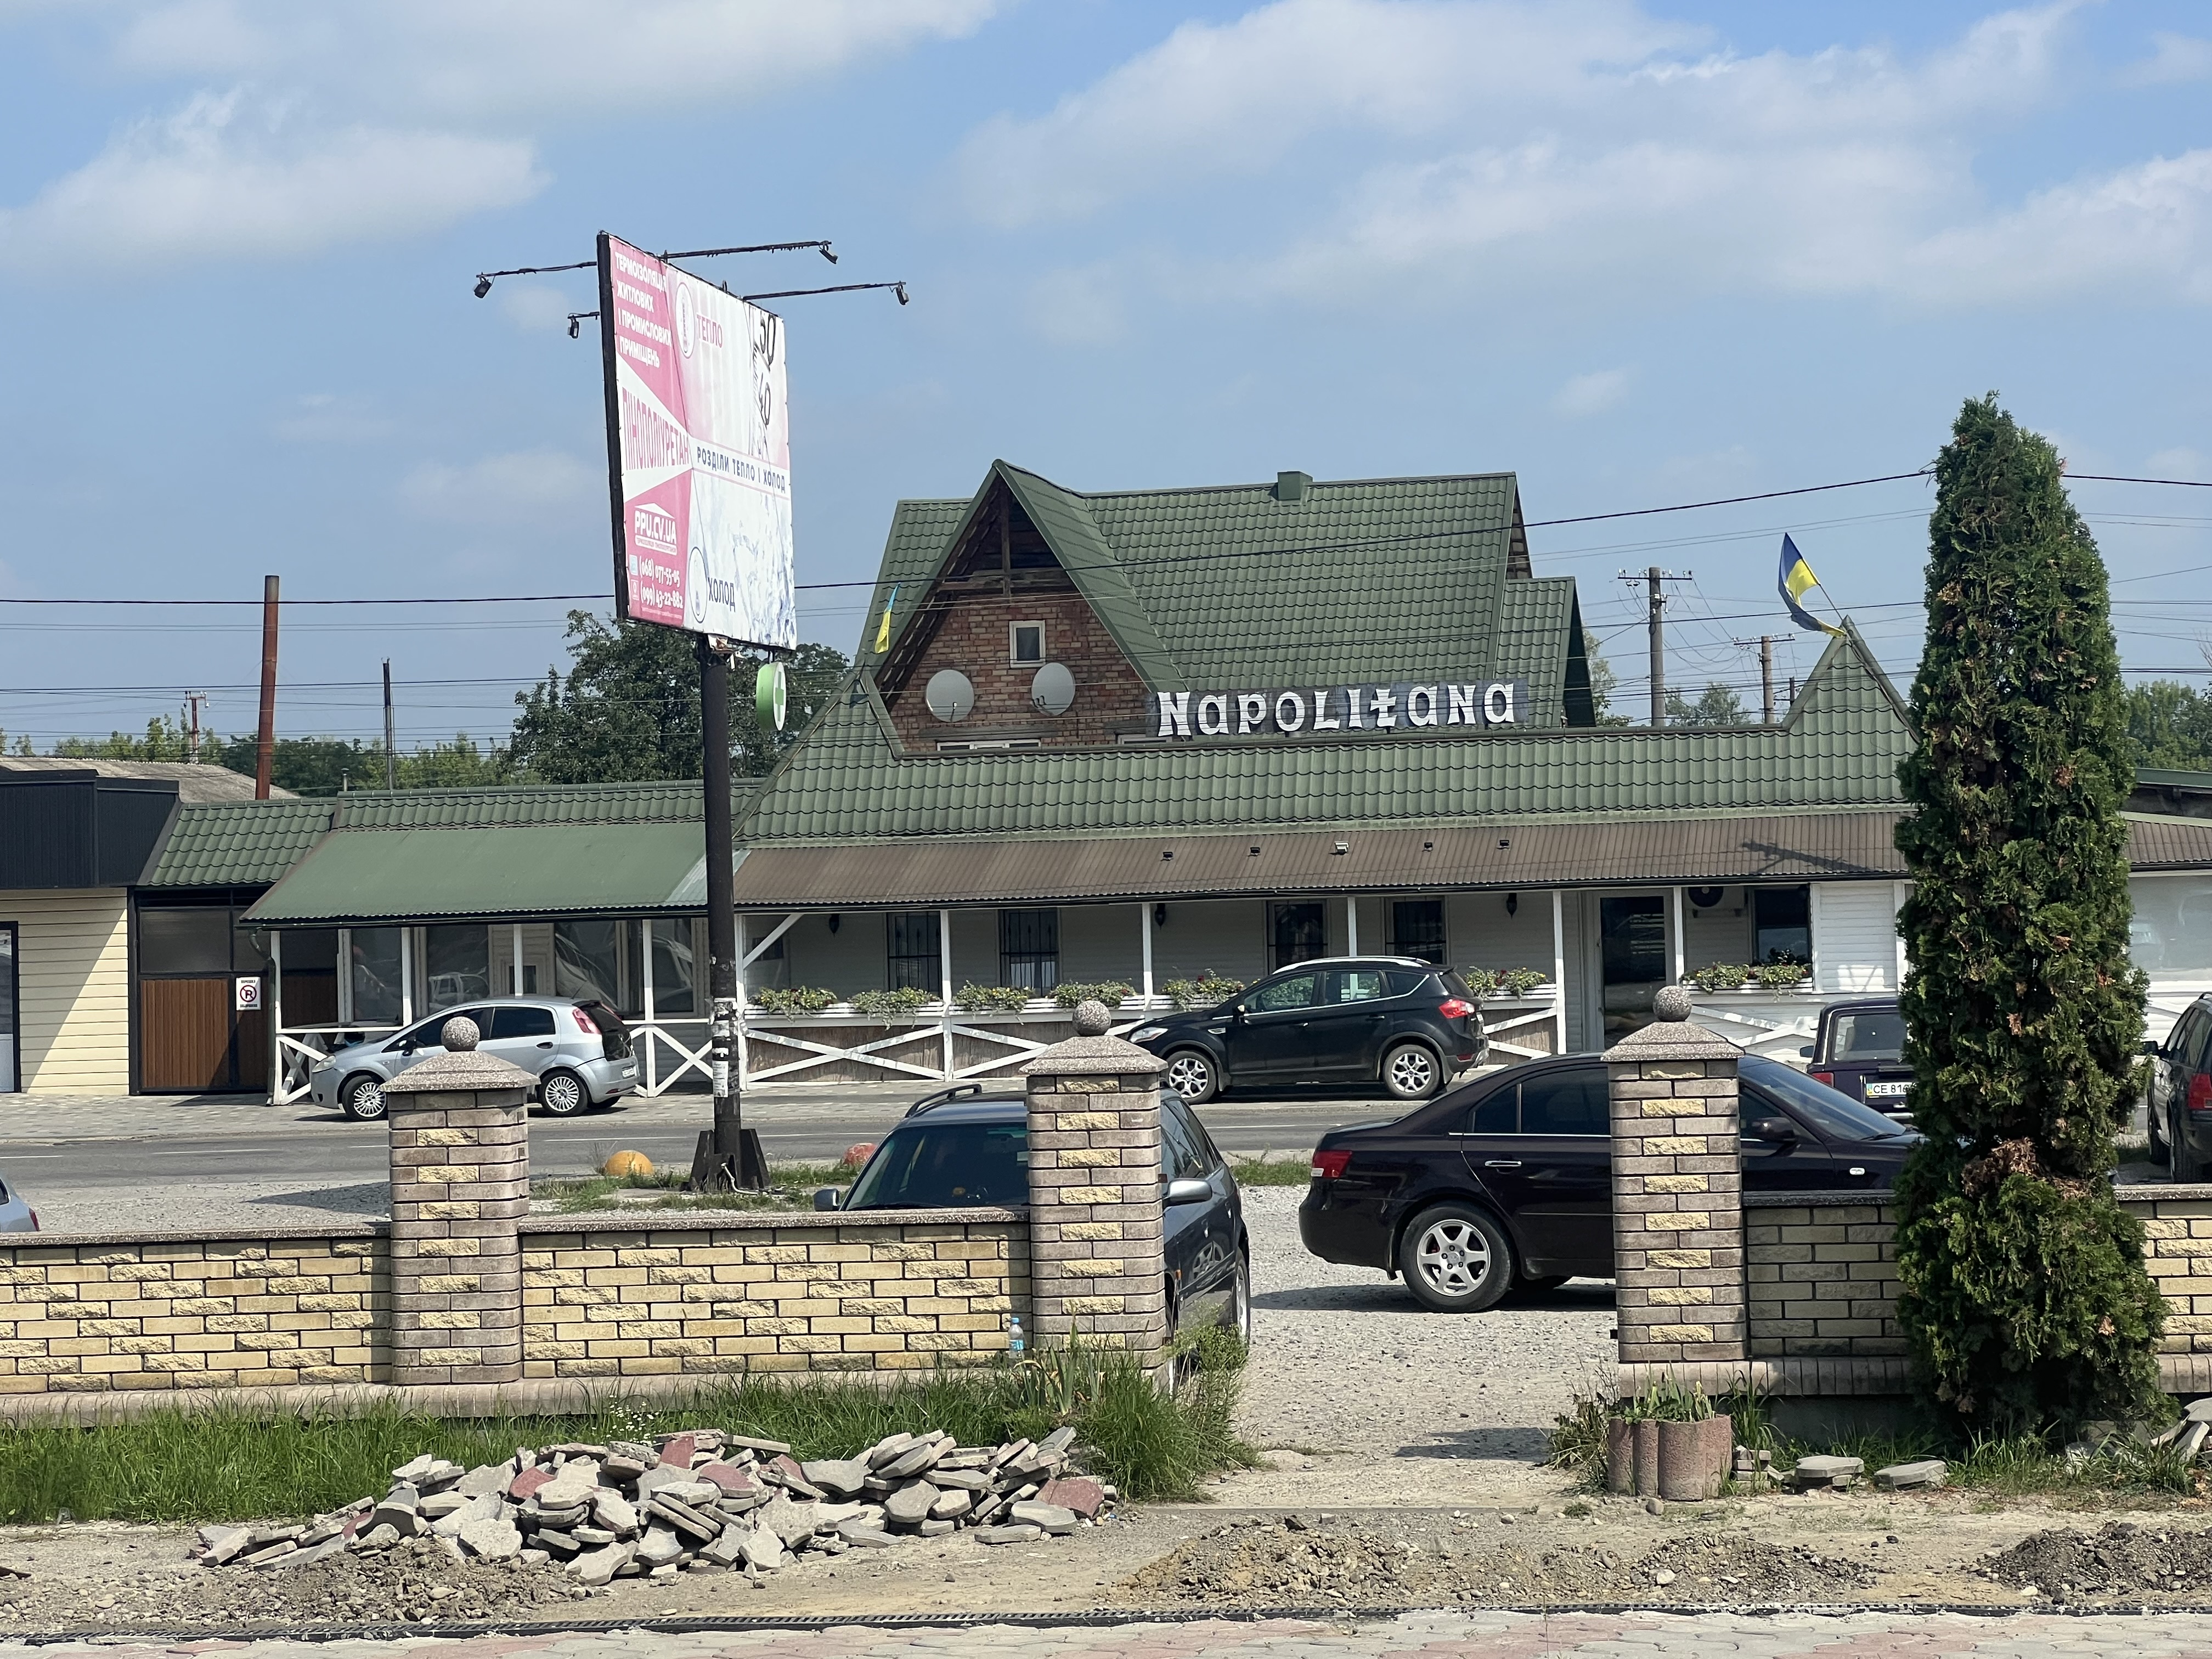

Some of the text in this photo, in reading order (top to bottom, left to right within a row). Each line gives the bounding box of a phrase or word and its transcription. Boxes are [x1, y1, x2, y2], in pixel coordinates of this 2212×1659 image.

[615, 252, 667, 292] ТЕРМОІЗОЛЯЦІЯ
[617, 279, 654, 313] ЖИТЛОВИХ
[618, 307, 672, 347] І ПРОМИСЛОВИХ
[697, 314, 723, 348] ТЕПЛО
[619, 335, 660, 368] ПРИМІЩЕНЬ
[622, 386, 689, 471] ПІНОПОЛІУРЕТАН
[697, 446, 786, 494] РОЗДІЛИ ТЕПЛО І ХОЛОД
[635, 510, 677, 545] PPU.CV.UA
[639, 555, 654, 581] (068)
[640, 580, 655, 606] (099)
[708, 577, 736, 612] ХОЛОД
[1873, 1085, 1888, 1094] CE
